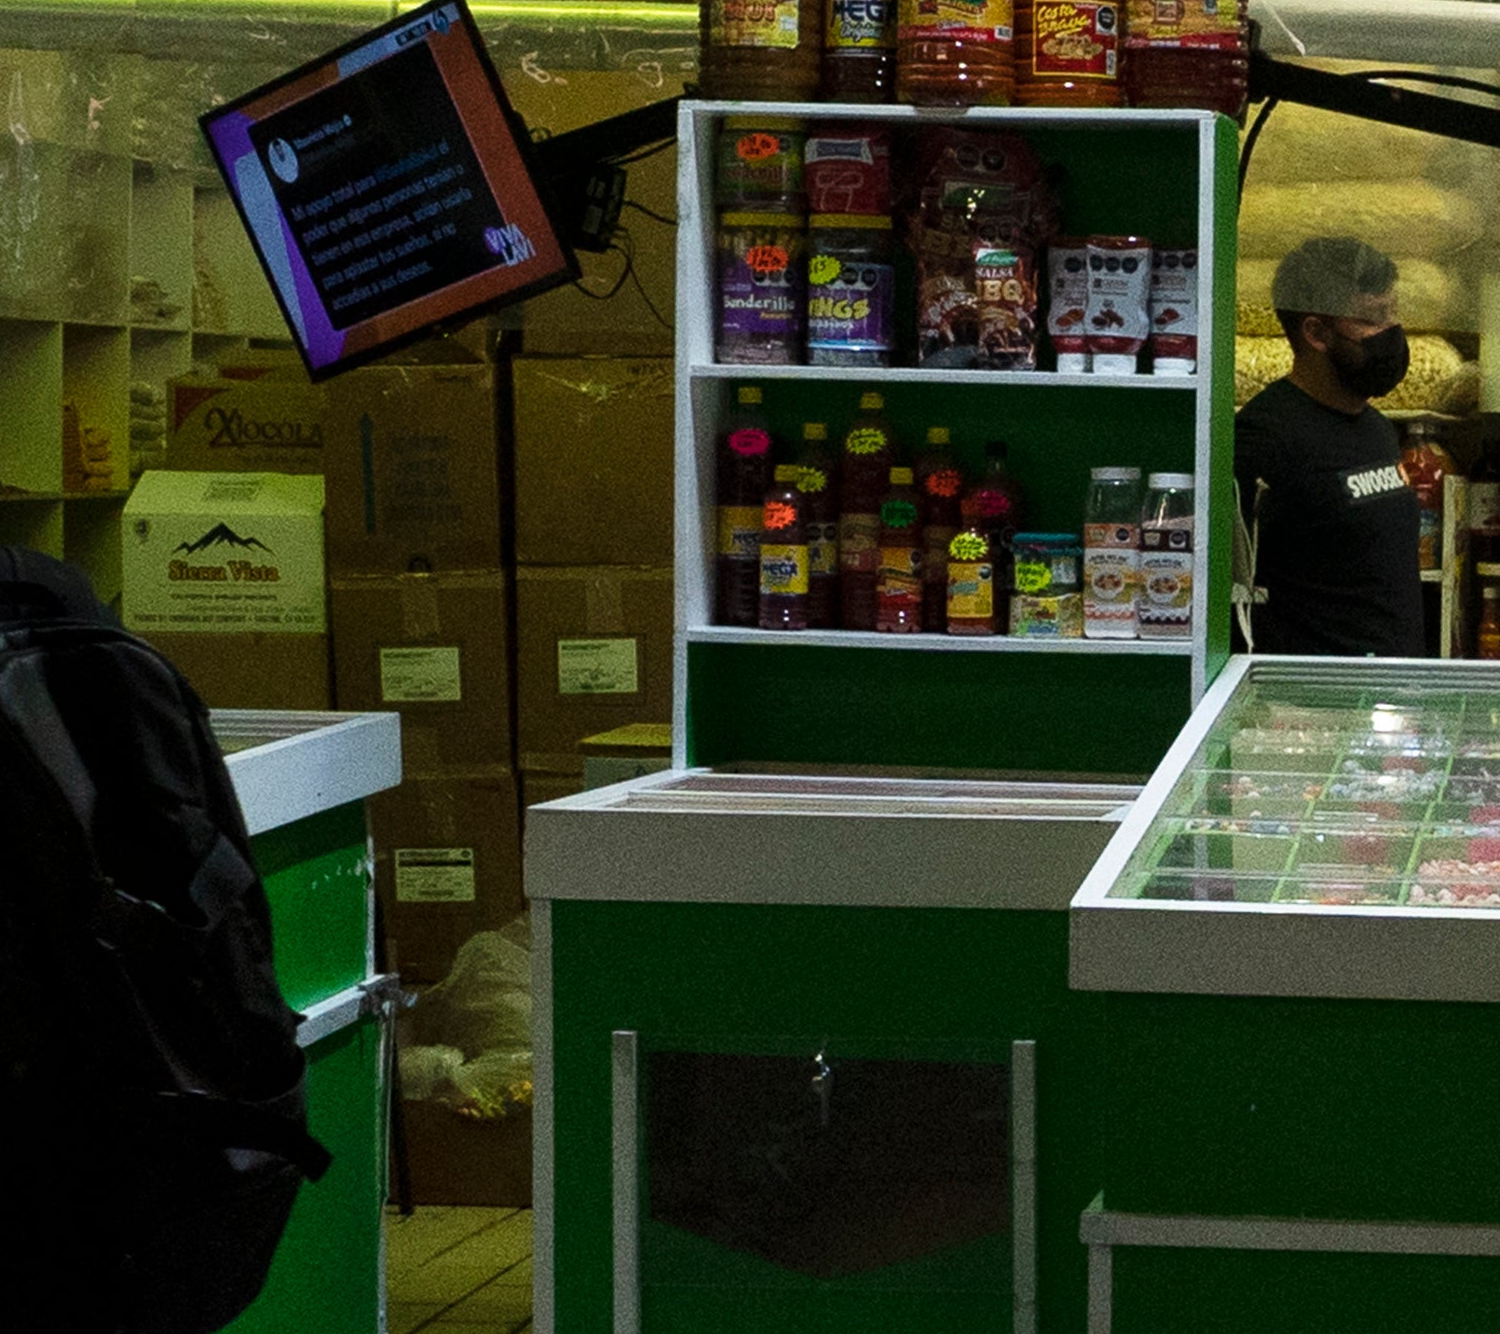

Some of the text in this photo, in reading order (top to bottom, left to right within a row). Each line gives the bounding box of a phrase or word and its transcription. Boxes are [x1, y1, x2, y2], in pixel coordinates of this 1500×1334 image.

[976, 279, 1023, 304] BQ
[168, 559, 280, 582] Sierra Vista
